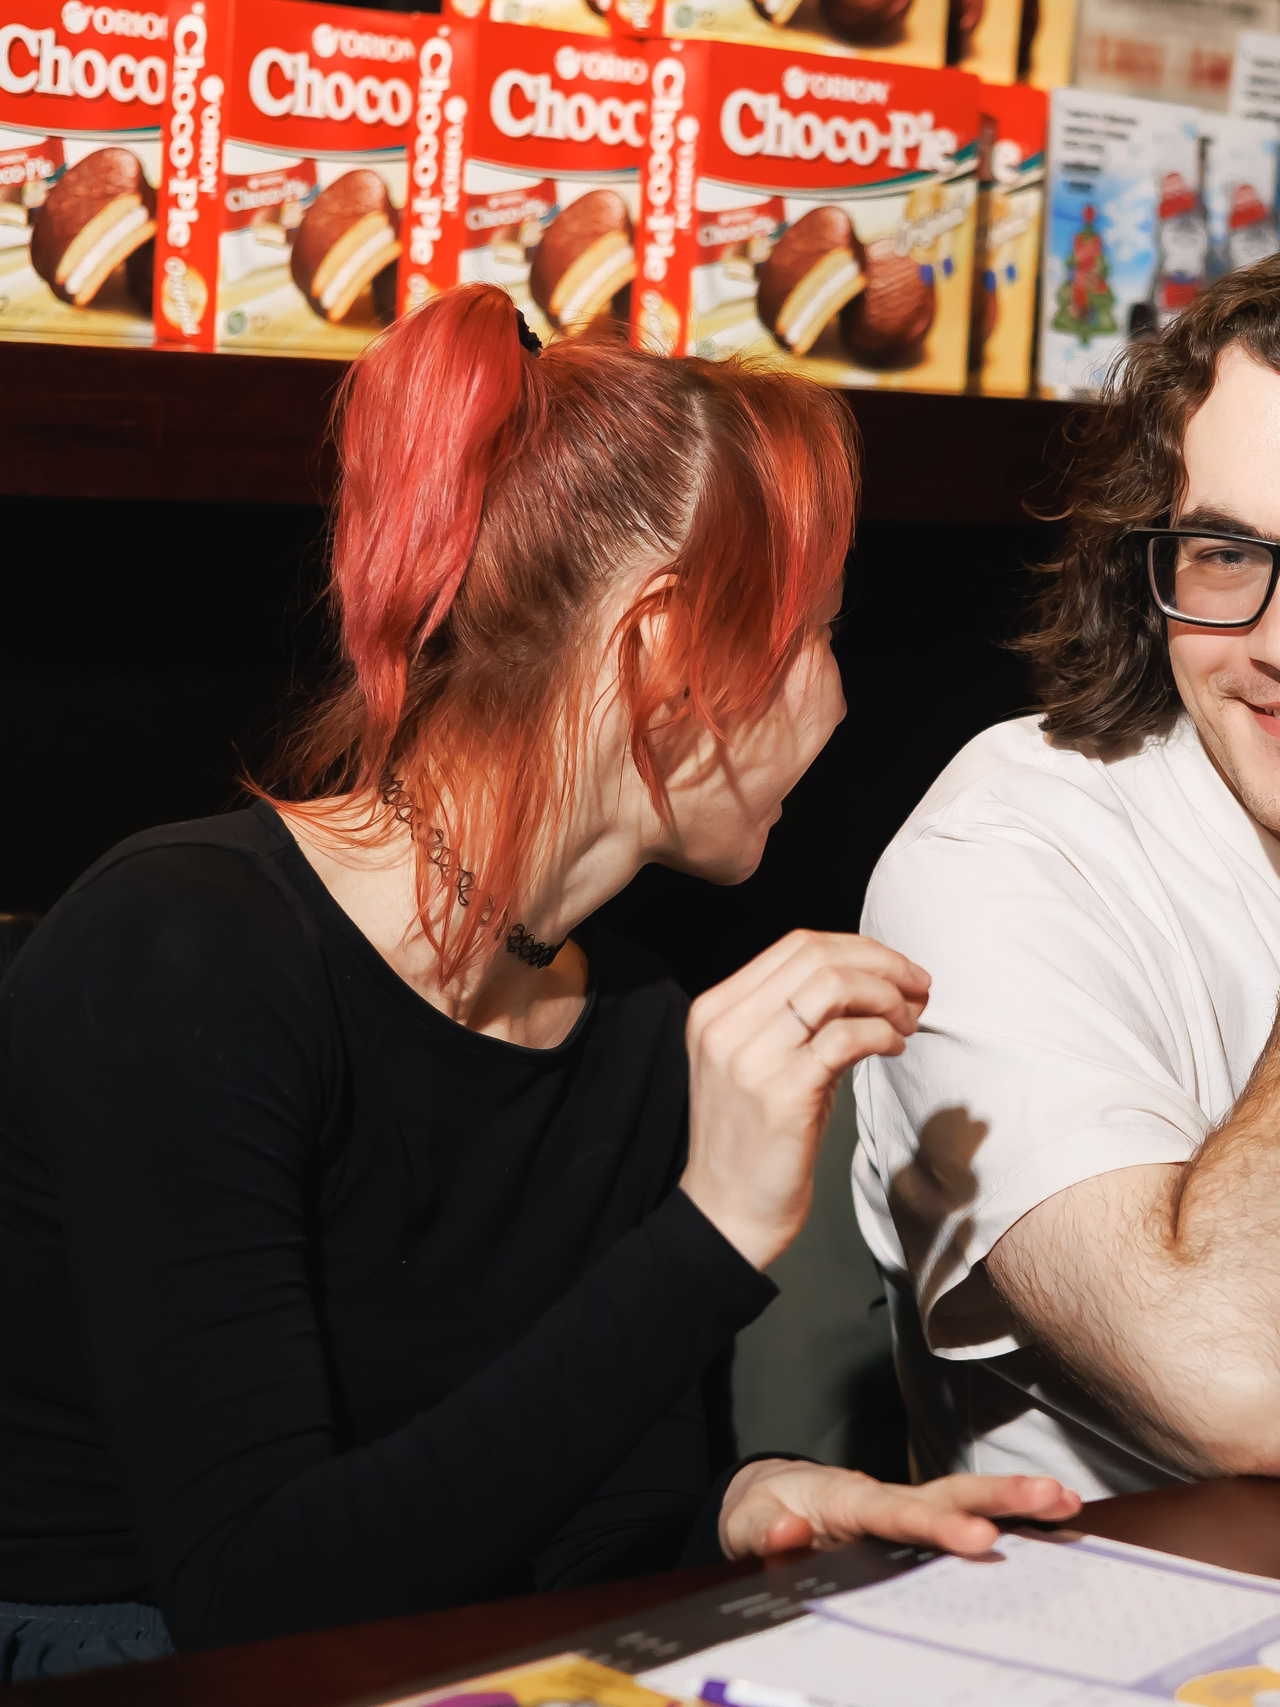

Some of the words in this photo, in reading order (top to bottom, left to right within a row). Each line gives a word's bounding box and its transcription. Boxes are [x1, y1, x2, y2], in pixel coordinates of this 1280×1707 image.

[0, 24, 166, 105] Choco
[248, 47, 413, 126] Choco
[583, 51, 648, 86] ORIO
[719, 88, 960, 174] Choco-Pie
